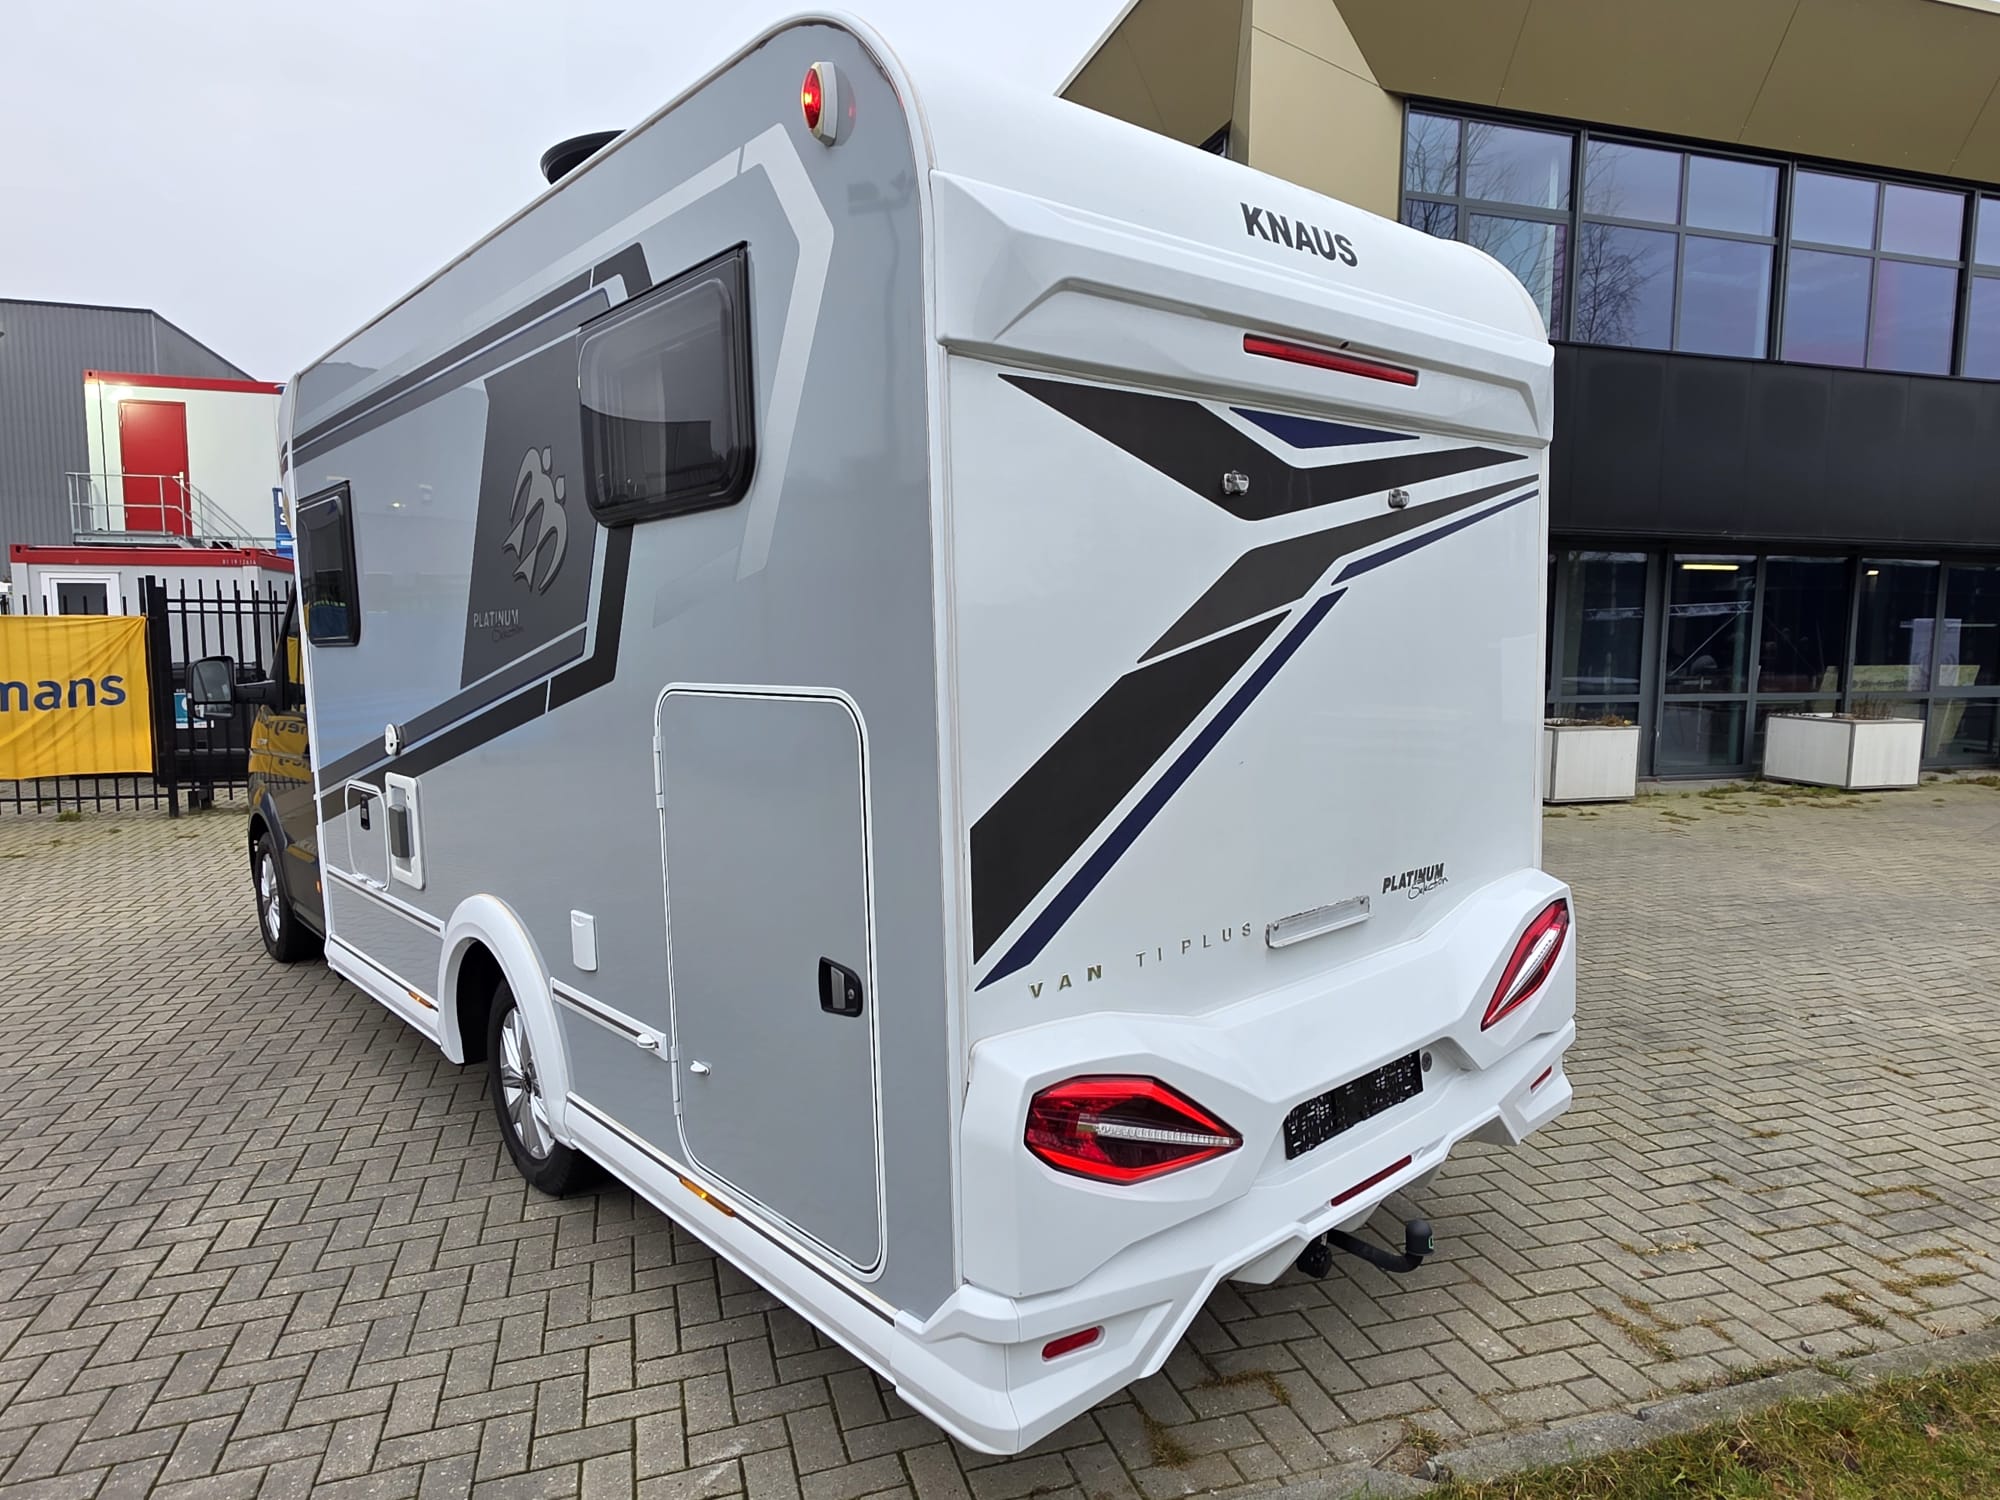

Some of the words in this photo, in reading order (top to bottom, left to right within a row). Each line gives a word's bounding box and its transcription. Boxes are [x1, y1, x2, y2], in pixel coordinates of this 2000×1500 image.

[1240, 202, 1358, 267] KNAUS
[473, 608, 519, 628] PLATINUM
[1382, 862, 1445, 894] PLATINUM
[1030, 965, 1102, 998] VAN
